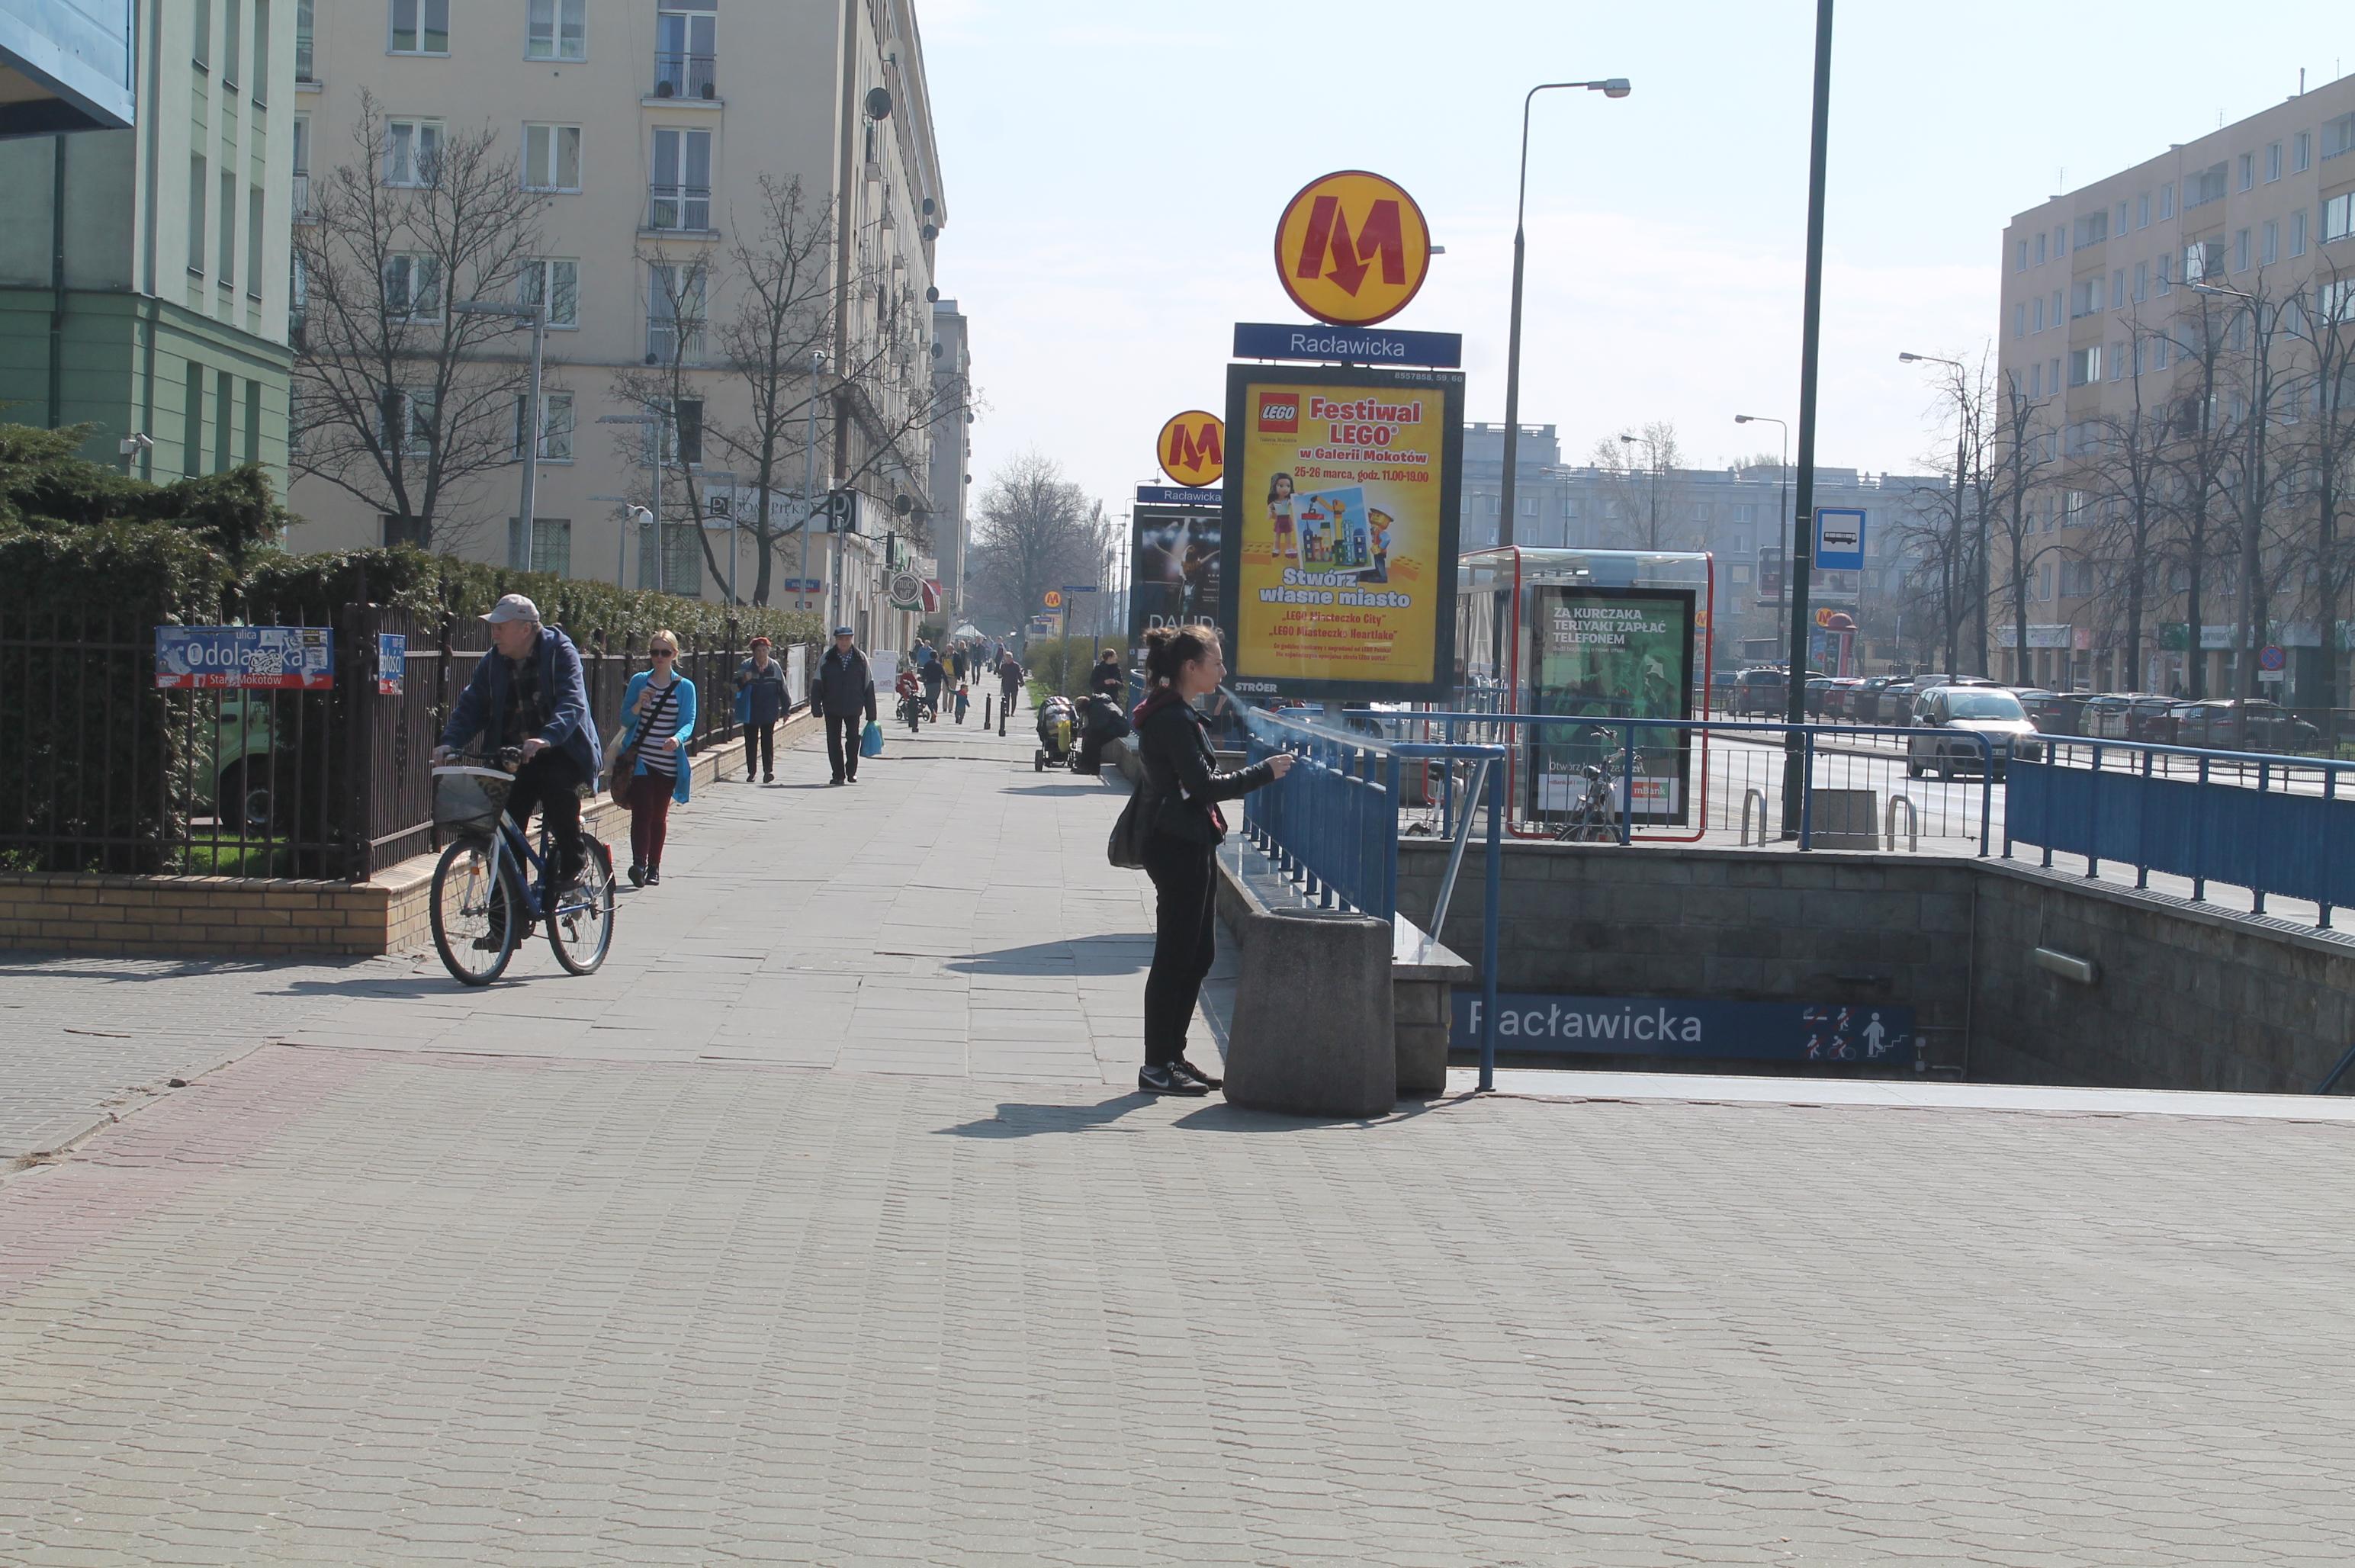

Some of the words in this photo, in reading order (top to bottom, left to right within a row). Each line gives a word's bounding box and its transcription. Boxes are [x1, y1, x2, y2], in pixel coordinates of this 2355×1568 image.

[1290, 333, 1405, 357] Racławicka
[1262, 405, 1296, 420] LEGO
[1310, 397, 1422, 423] Festiwal
[1300, 448, 1312, 459] w
[1315, 448, 1360, 461] Galerii
[1364, 448, 1428, 464] Mokotów
[1294, 466, 1321, 477] 25-26
[1323, 468, 1354, 480] marca,
[1357, 468, 1380, 483] godz.
[1382, 470, 1429, 483] 11.00-19.00
[1164, 490, 1222, 503] Racławicka
[1283, 567, 1357, 588] Stwórz
[1259, 585, 1334, 605] własne
[1338, 588, 1411, 608] miasto
[1309, 611, 1361, 623] Miasteczko
[1553, 607, 1571, 619] ZA
[1574, 608, 1643, 620] KURCZAKA
[1296, 626, 1348, 638] Miasteczko
[1553, 619, 1614, 632] TERIYAKI
[1617, 619, 1666, 633] ZAPŁAĆ
[236, 629, 257, 641] ulica
[1553, 631, 1625, 644] TELEFONEM
[210, 674, 231, 686] Star
[238, 674, 282, 686] Mokotów
[1235, 683, 1277, 692] STRÖER
[1634, 786, 1666, 795] mBank
